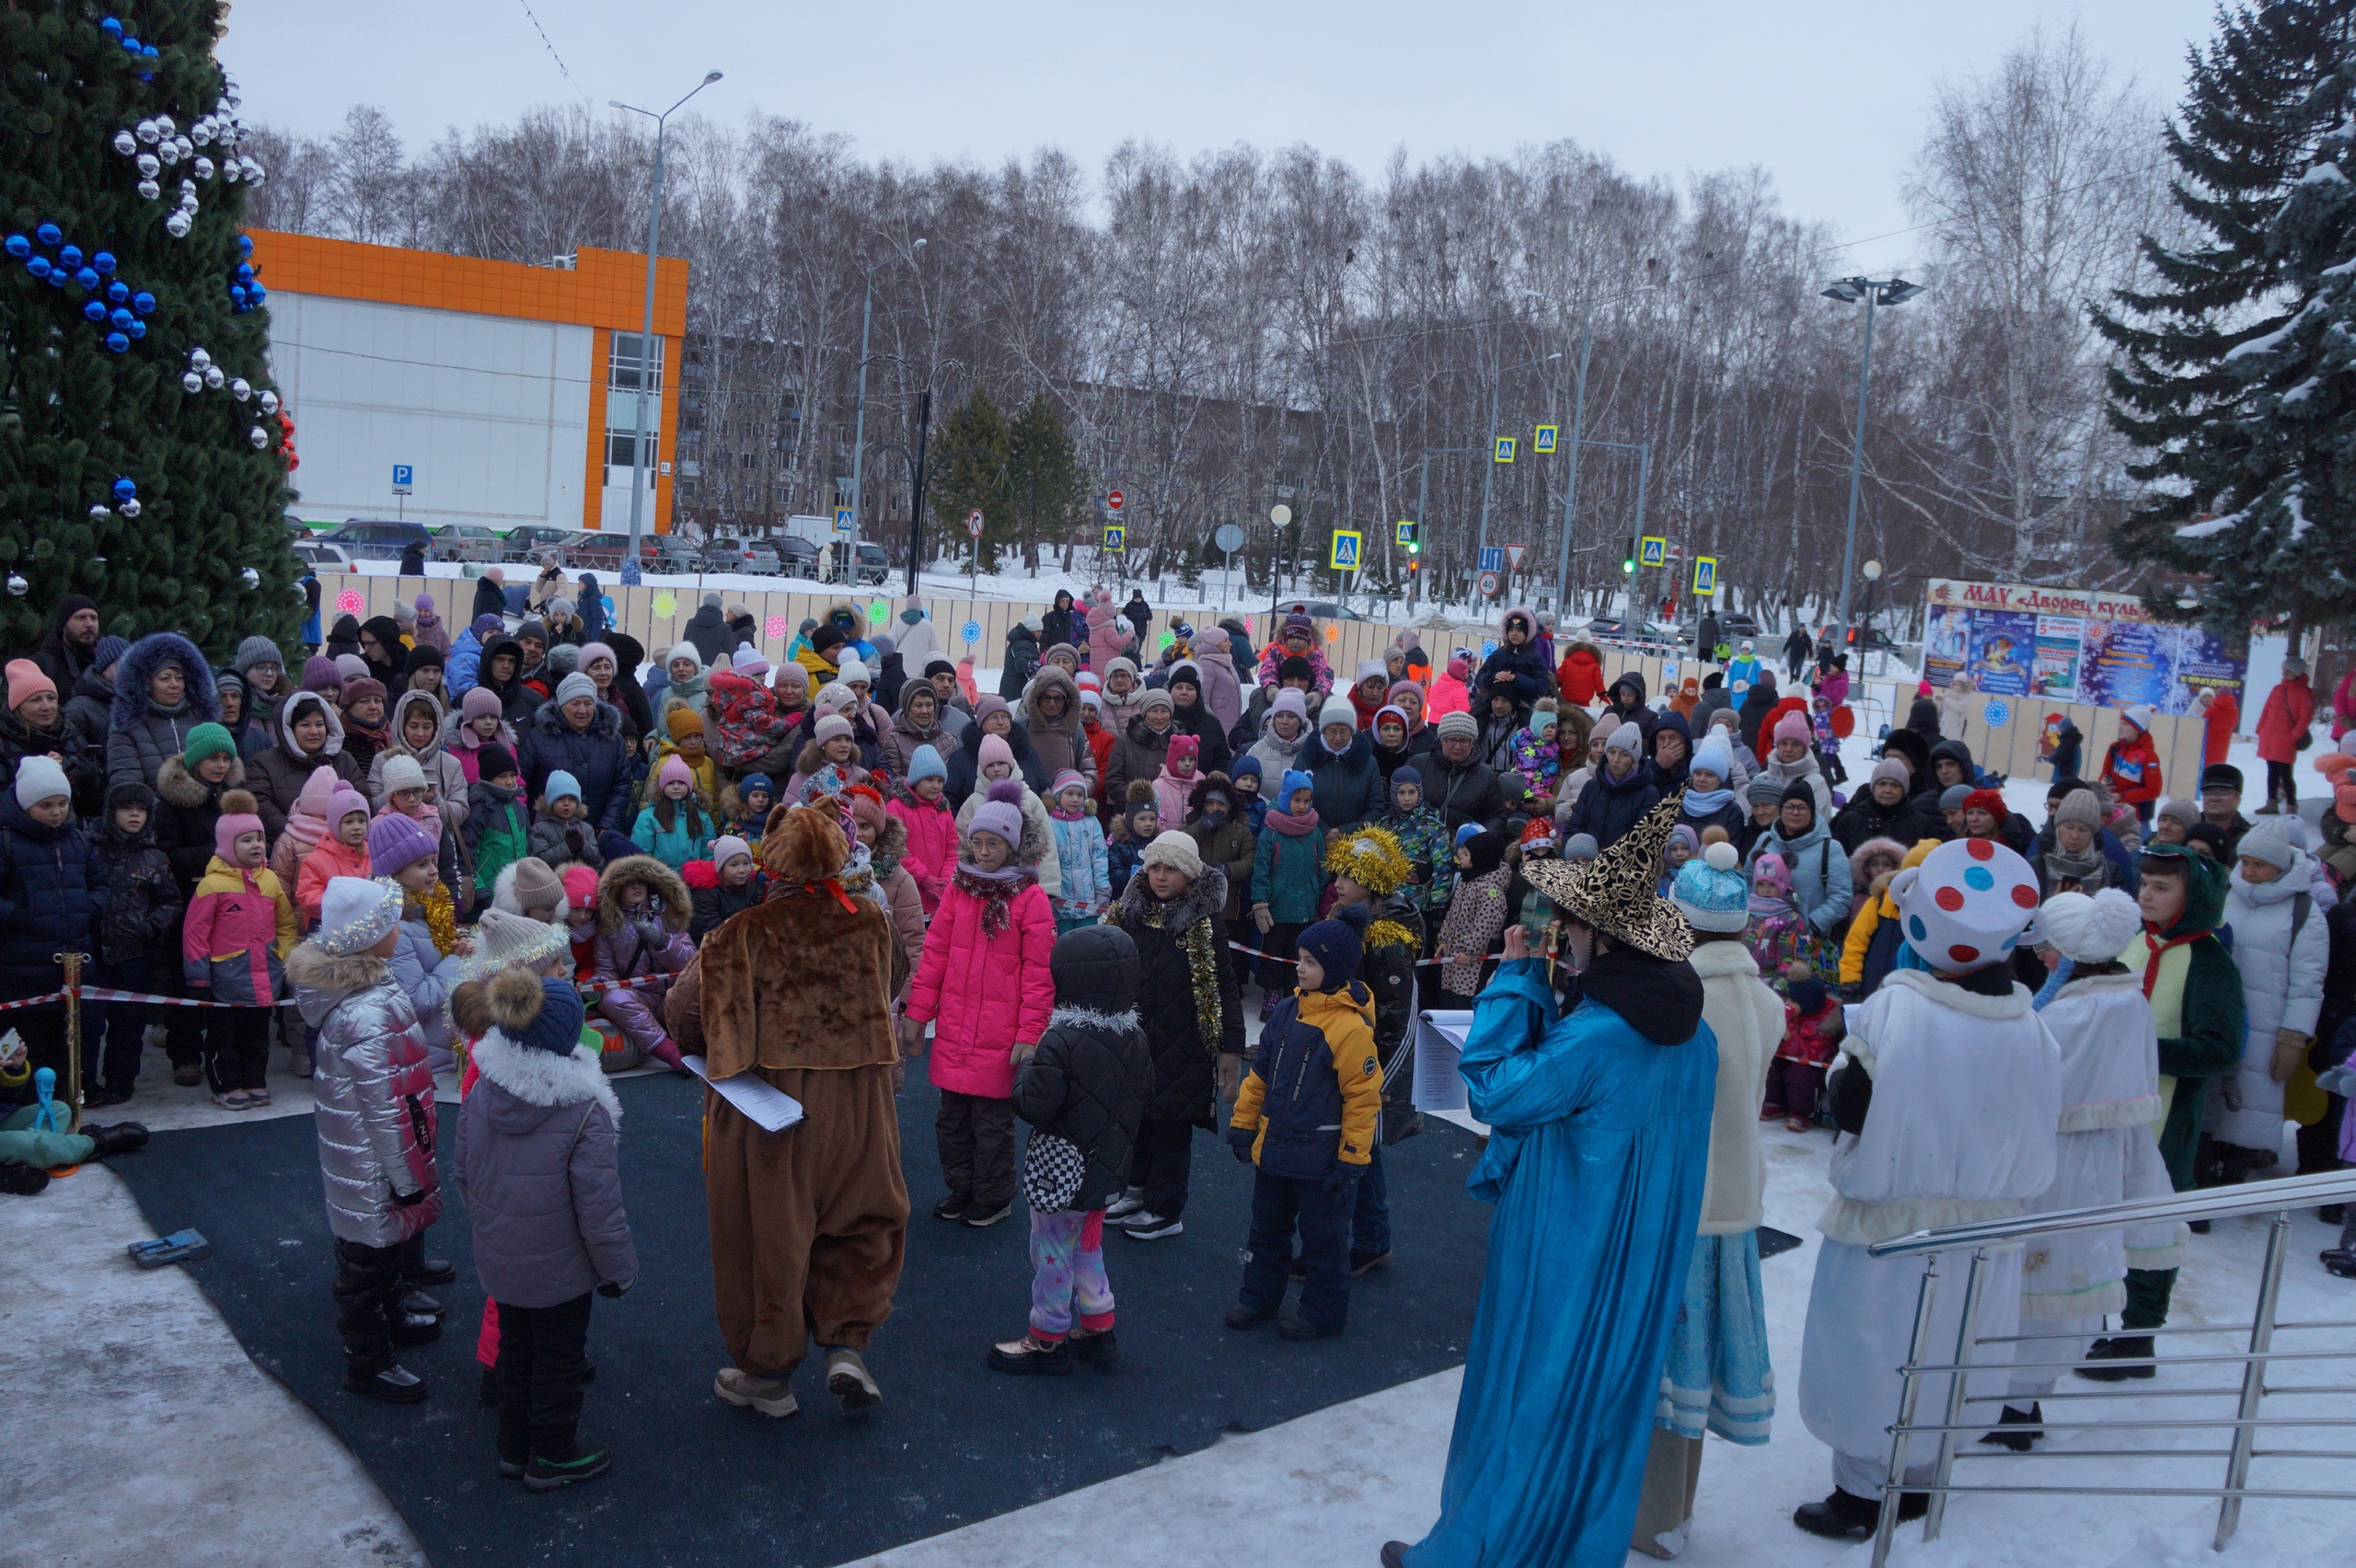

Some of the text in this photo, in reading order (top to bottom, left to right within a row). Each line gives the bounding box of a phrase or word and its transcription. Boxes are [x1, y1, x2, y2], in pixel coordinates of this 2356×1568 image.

[397, 467, 409, 483] P
[1483, 581, 1494, 589] 40
[1532, 587, 1554, 596] СТОП
[1963, 584, 2013, 607] МАУ
[2038, 624, 2047, 635] 5
[2188, 676, 2241, 688] ПРАЗДНИКУ
